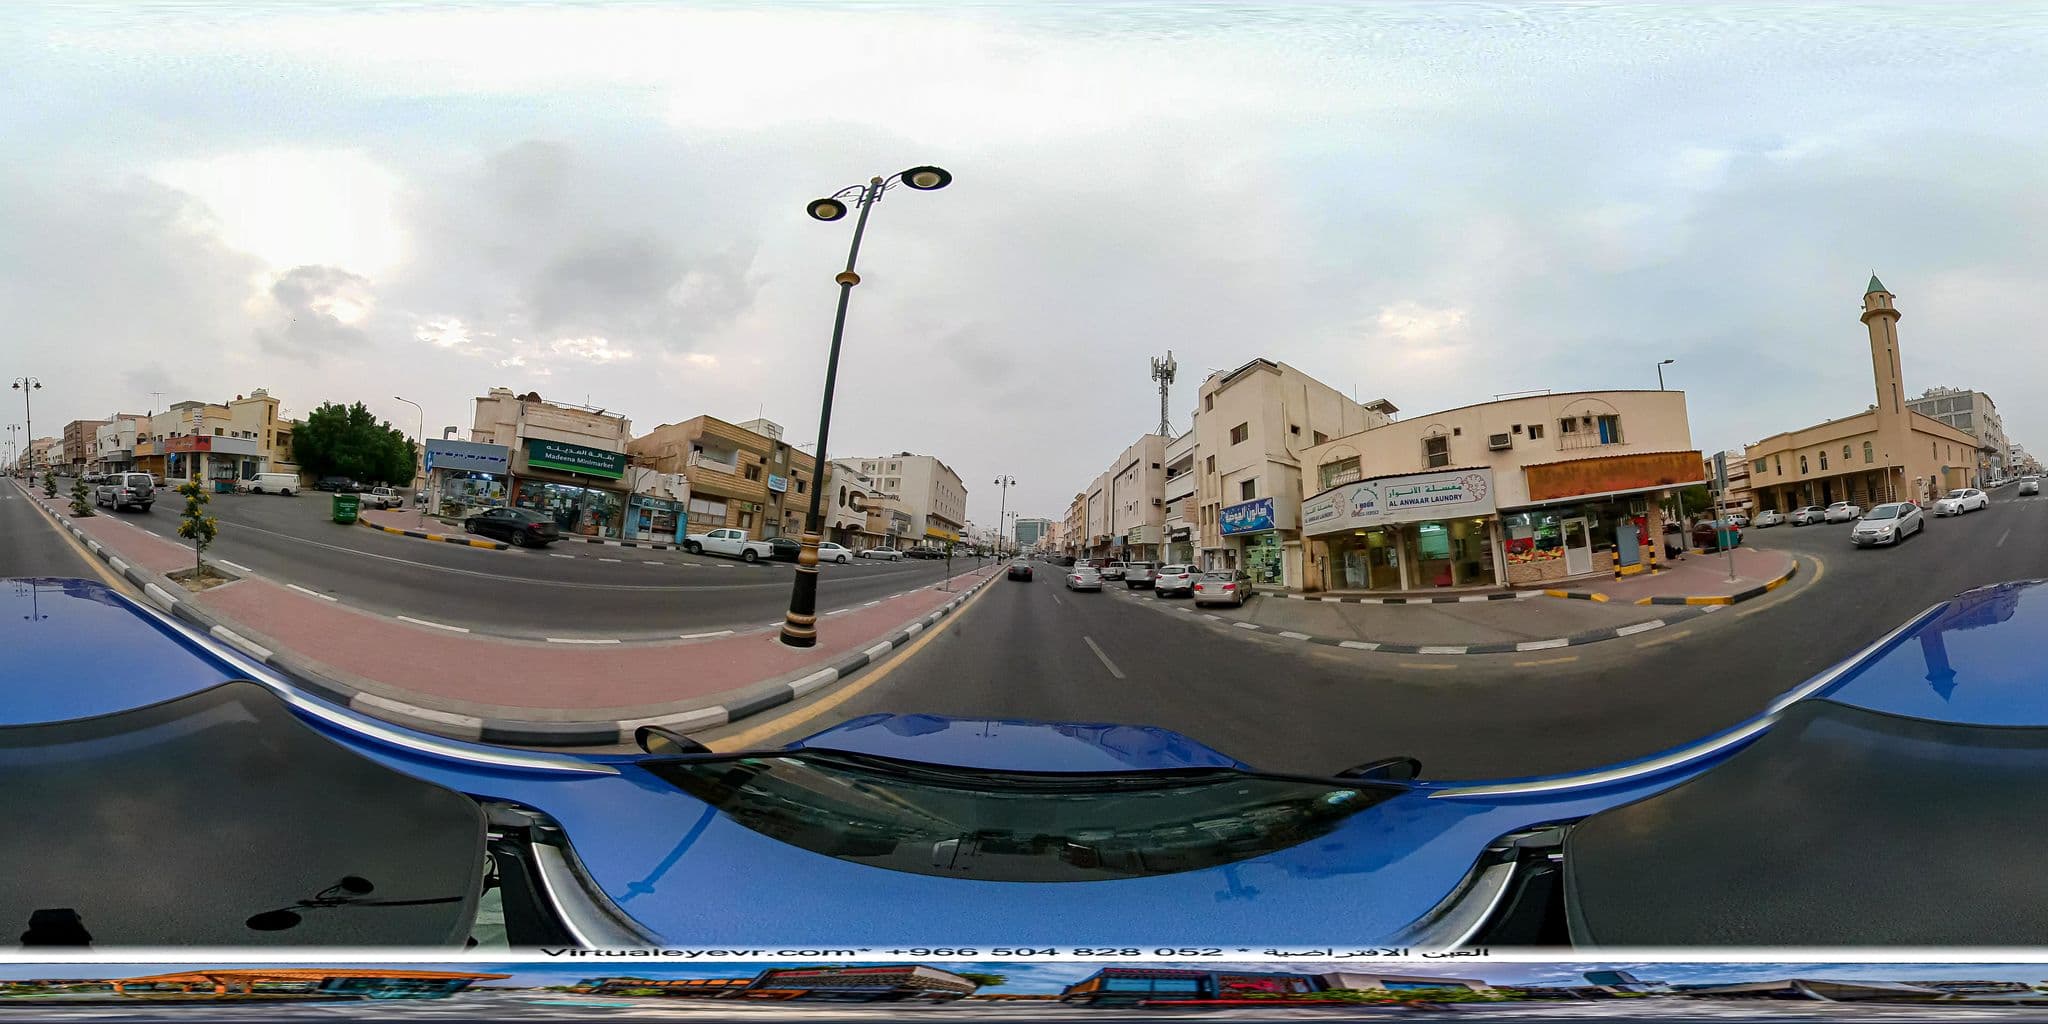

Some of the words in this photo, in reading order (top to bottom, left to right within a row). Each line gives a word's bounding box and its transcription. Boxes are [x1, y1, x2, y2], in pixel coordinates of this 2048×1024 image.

[545, 452, 575, 462] Madeena
[577, 456, 614, 469] Minimarket
[1400, 497, 1429, 506] ANWAAR
[1431, 494, 1462, 503] LAUNDRY
